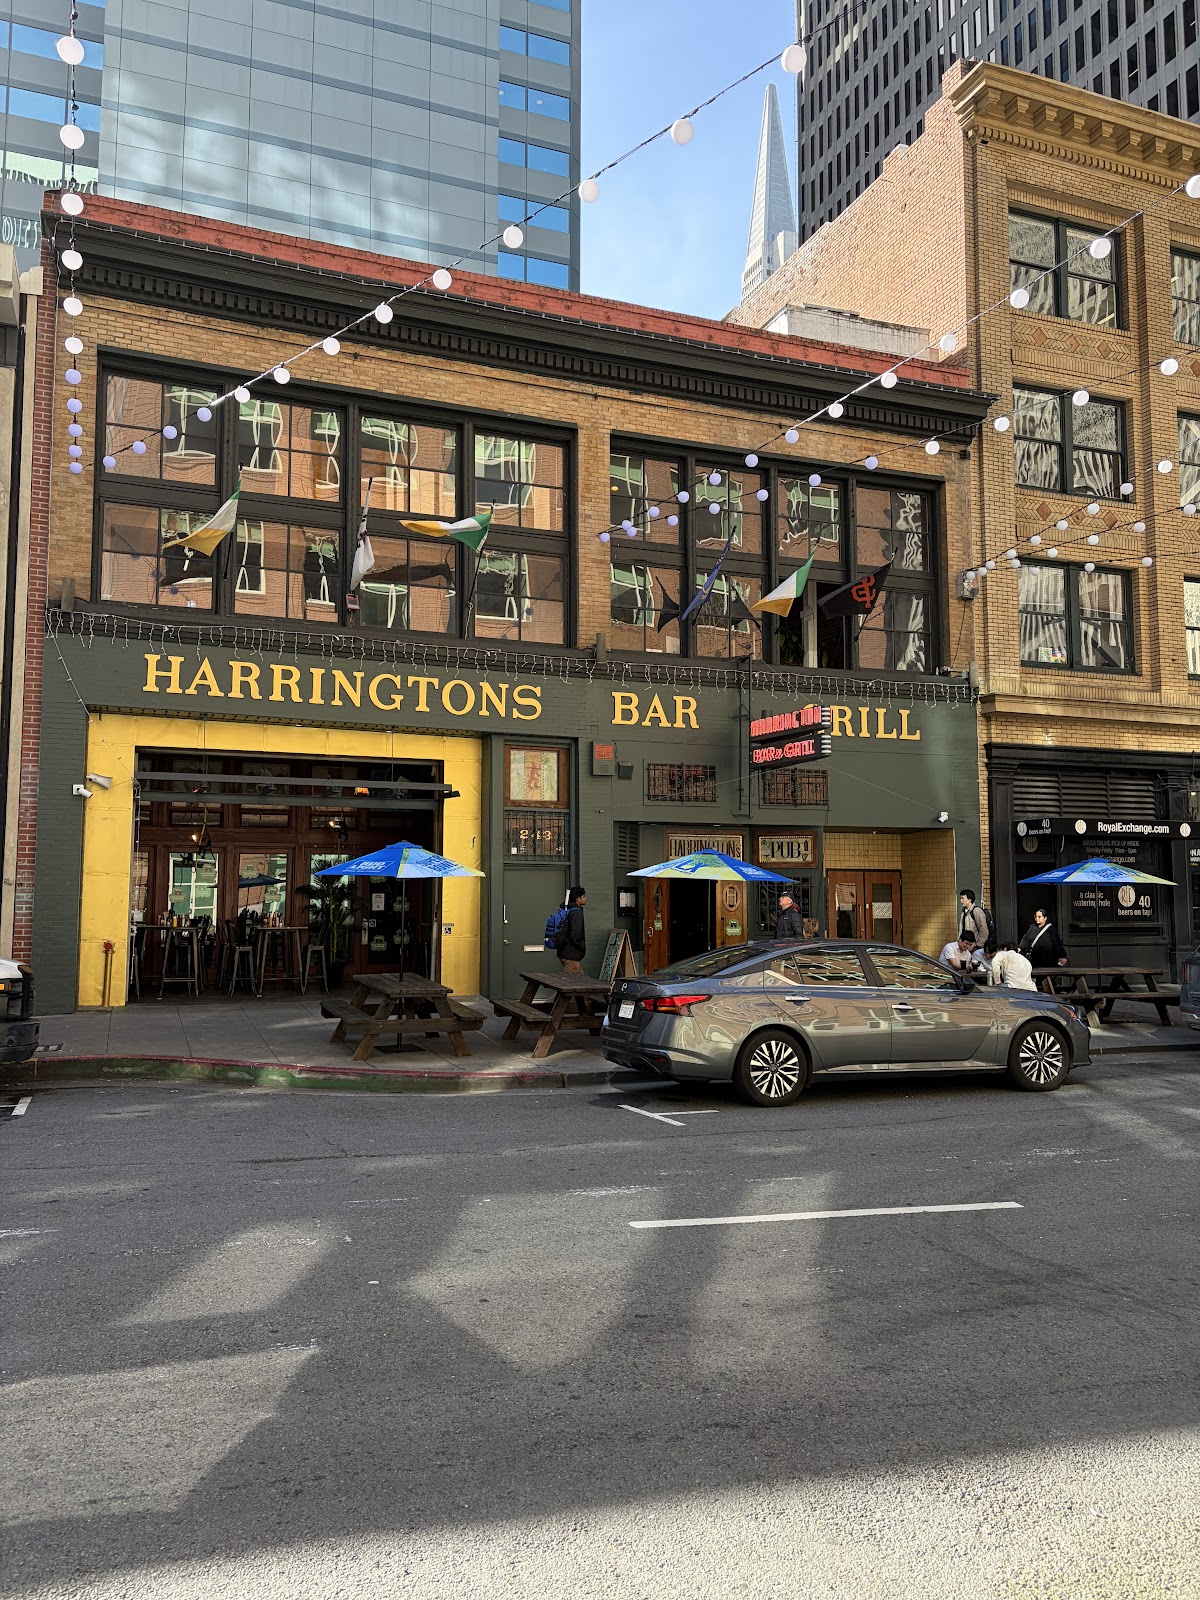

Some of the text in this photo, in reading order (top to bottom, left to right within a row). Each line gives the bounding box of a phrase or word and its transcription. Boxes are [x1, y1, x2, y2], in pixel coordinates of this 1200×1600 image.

[142, 653, 921, 740] HARRINGTONS BAR RILL
[753, 746, 775, 764] BAR
[783, 739, 815, 758] GRILL
[1041, 818, 1050, 828] 40
[1097, 821, 1170, 835] RoyalExchange.com
[771, 841, 801, 859] PUB
[1084, 891, 1104, 899] clasic
[1073, 899, 1111, 908] watering hole
[1138, 896, 1151, 908] 40
[1118, 908, 1134, 916] beers
[1143, 908, 1153, 918] tap!
